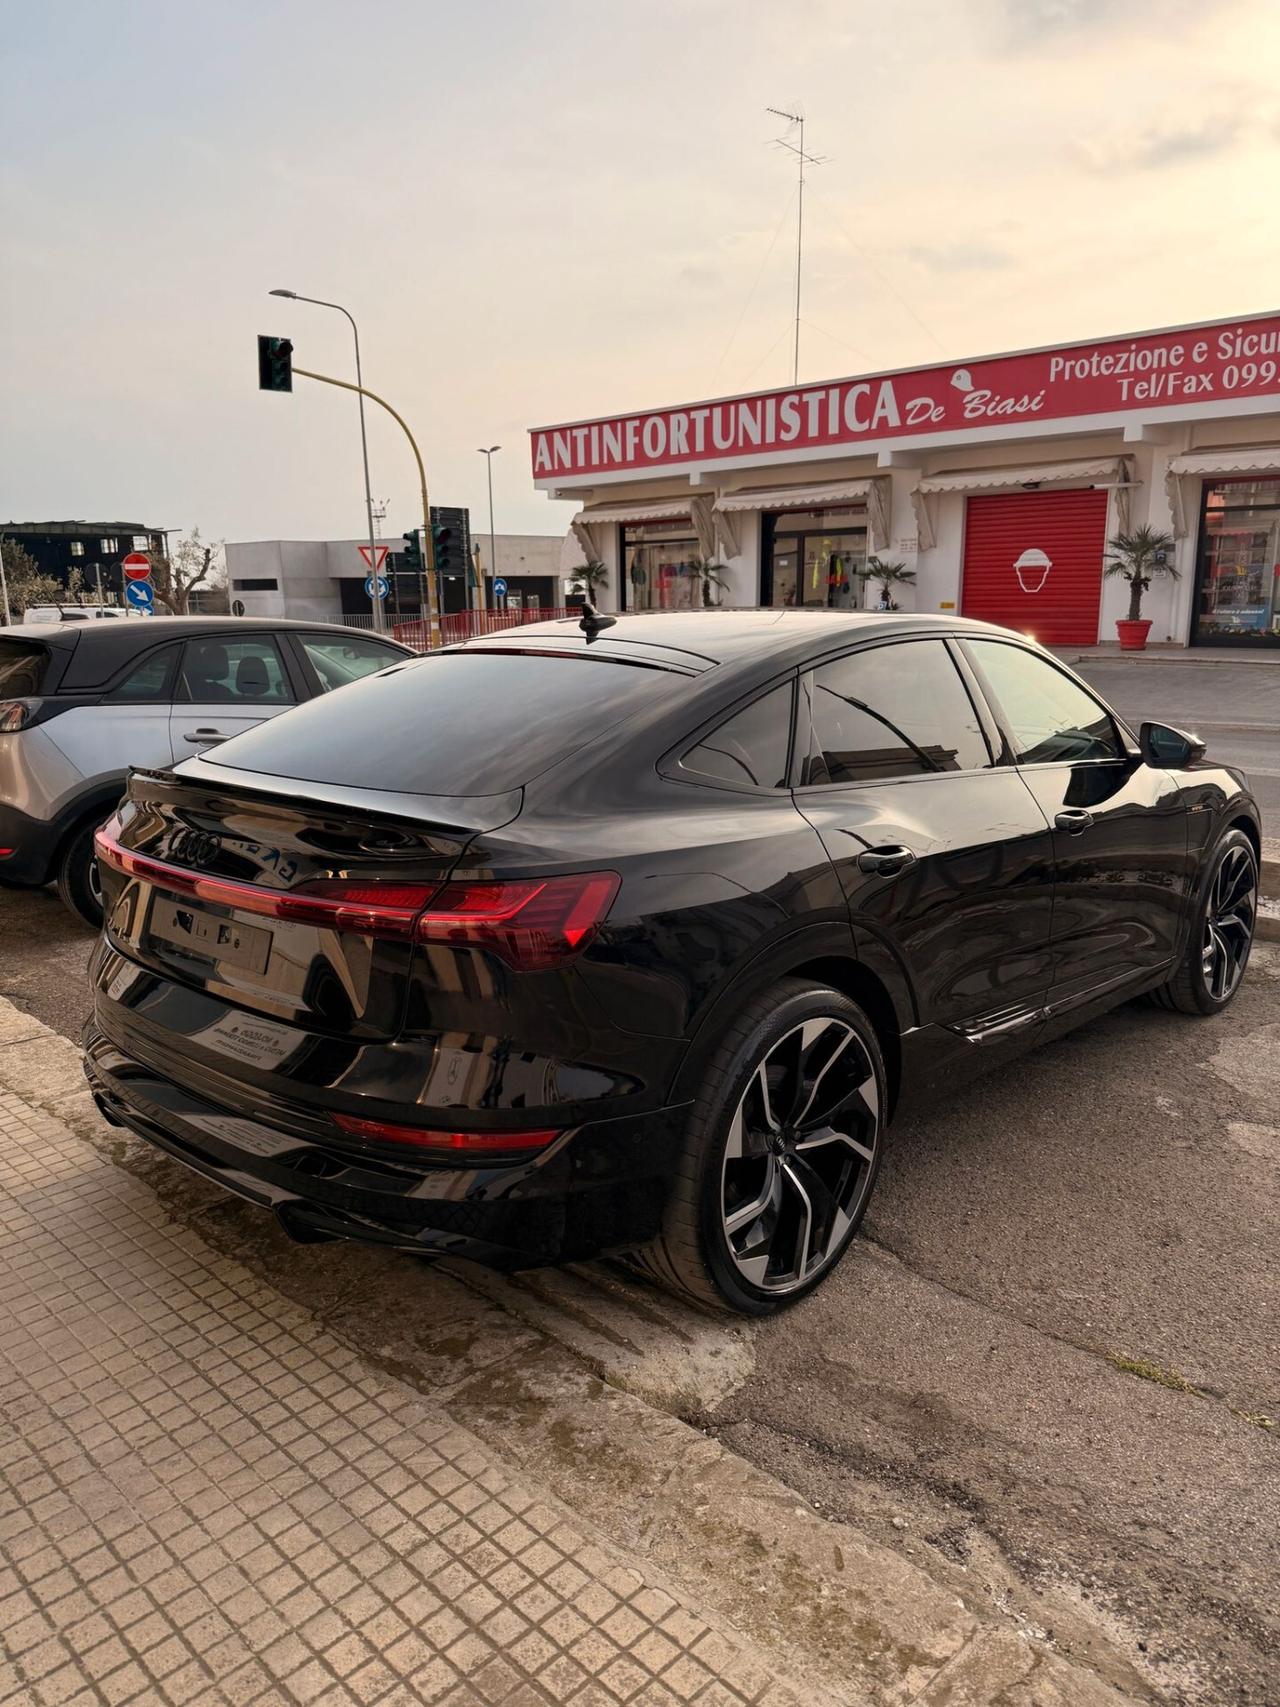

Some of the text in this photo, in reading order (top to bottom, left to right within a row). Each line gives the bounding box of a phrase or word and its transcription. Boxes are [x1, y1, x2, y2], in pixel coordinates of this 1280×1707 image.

[1050, 328, 1280, 382] Protezione e Sicu
[905, 389, 1046, 426] De Biasi
[1117, 371, 1213, 401] Tel/Fax
[535, 380, 901, 473] ANTINFORTUNISTICA
